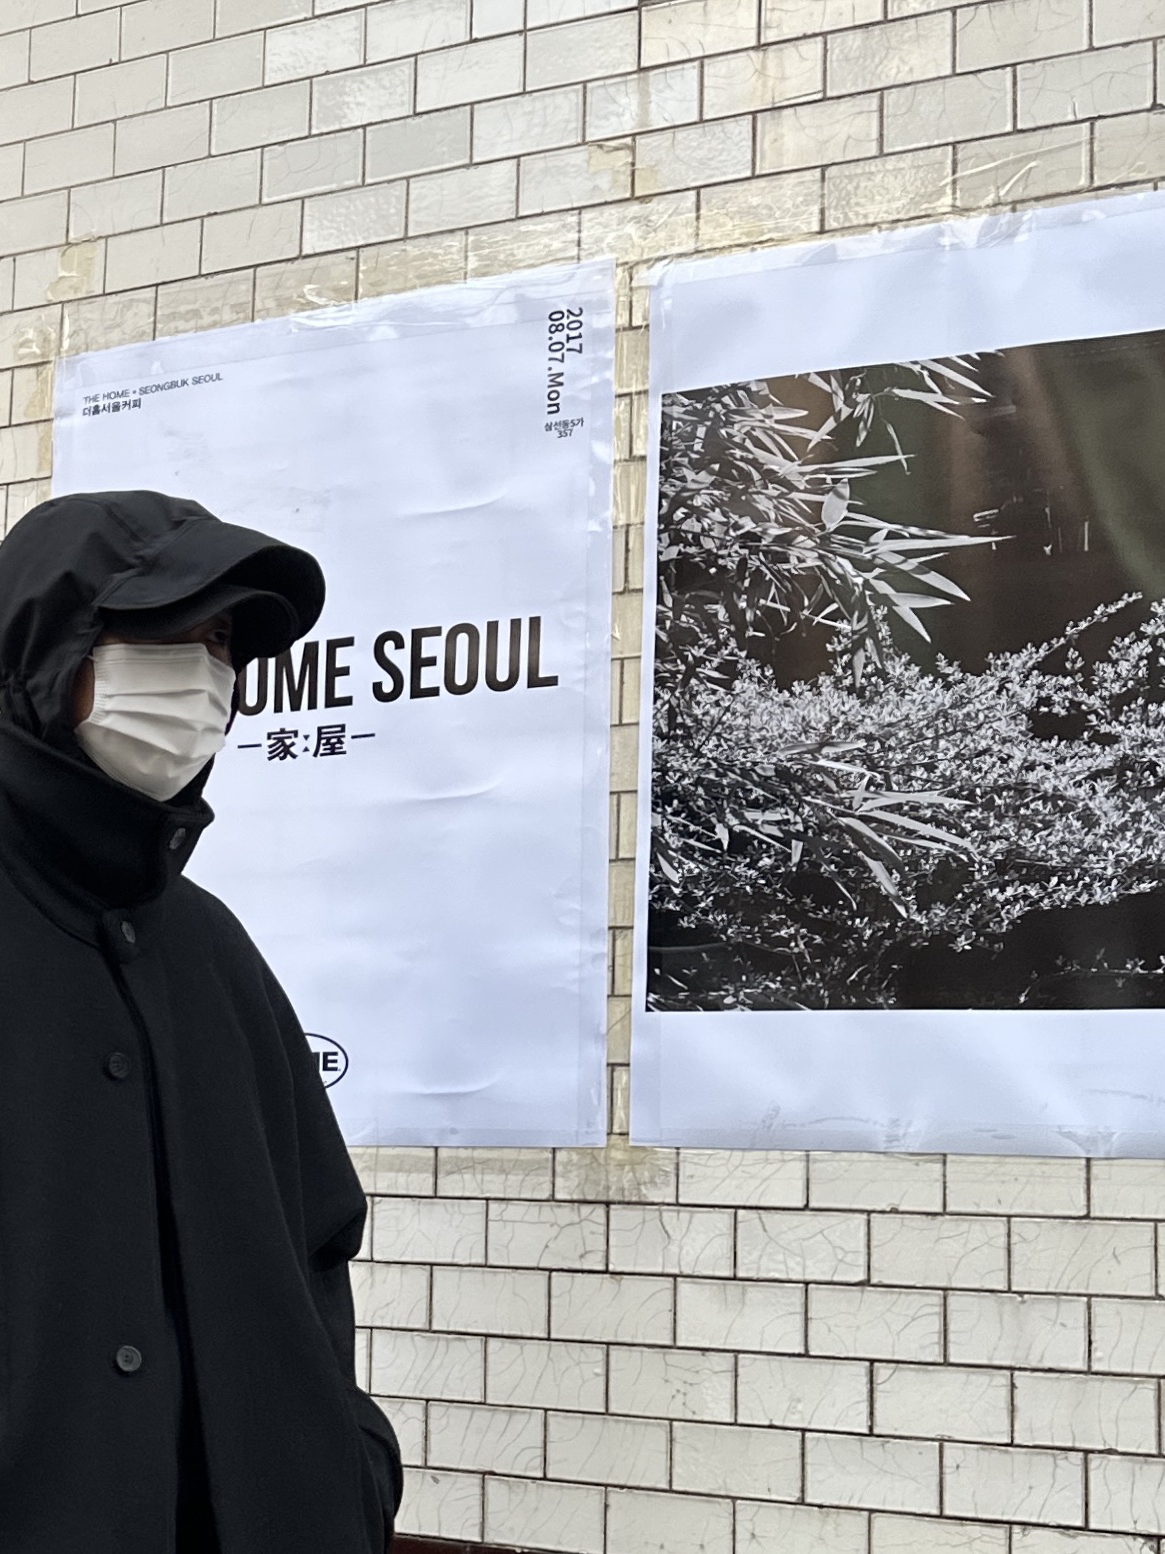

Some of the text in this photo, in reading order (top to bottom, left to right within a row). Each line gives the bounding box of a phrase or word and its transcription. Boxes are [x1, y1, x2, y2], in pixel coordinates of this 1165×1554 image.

[547, 310, 565, 415] 08.07.Mon
[566, 307, 583, 354] 2017
[83, 372, 223, 404] THE HOME SEONGBUK SEOUL
[237, 616, 558, 716] OME SEOUL
